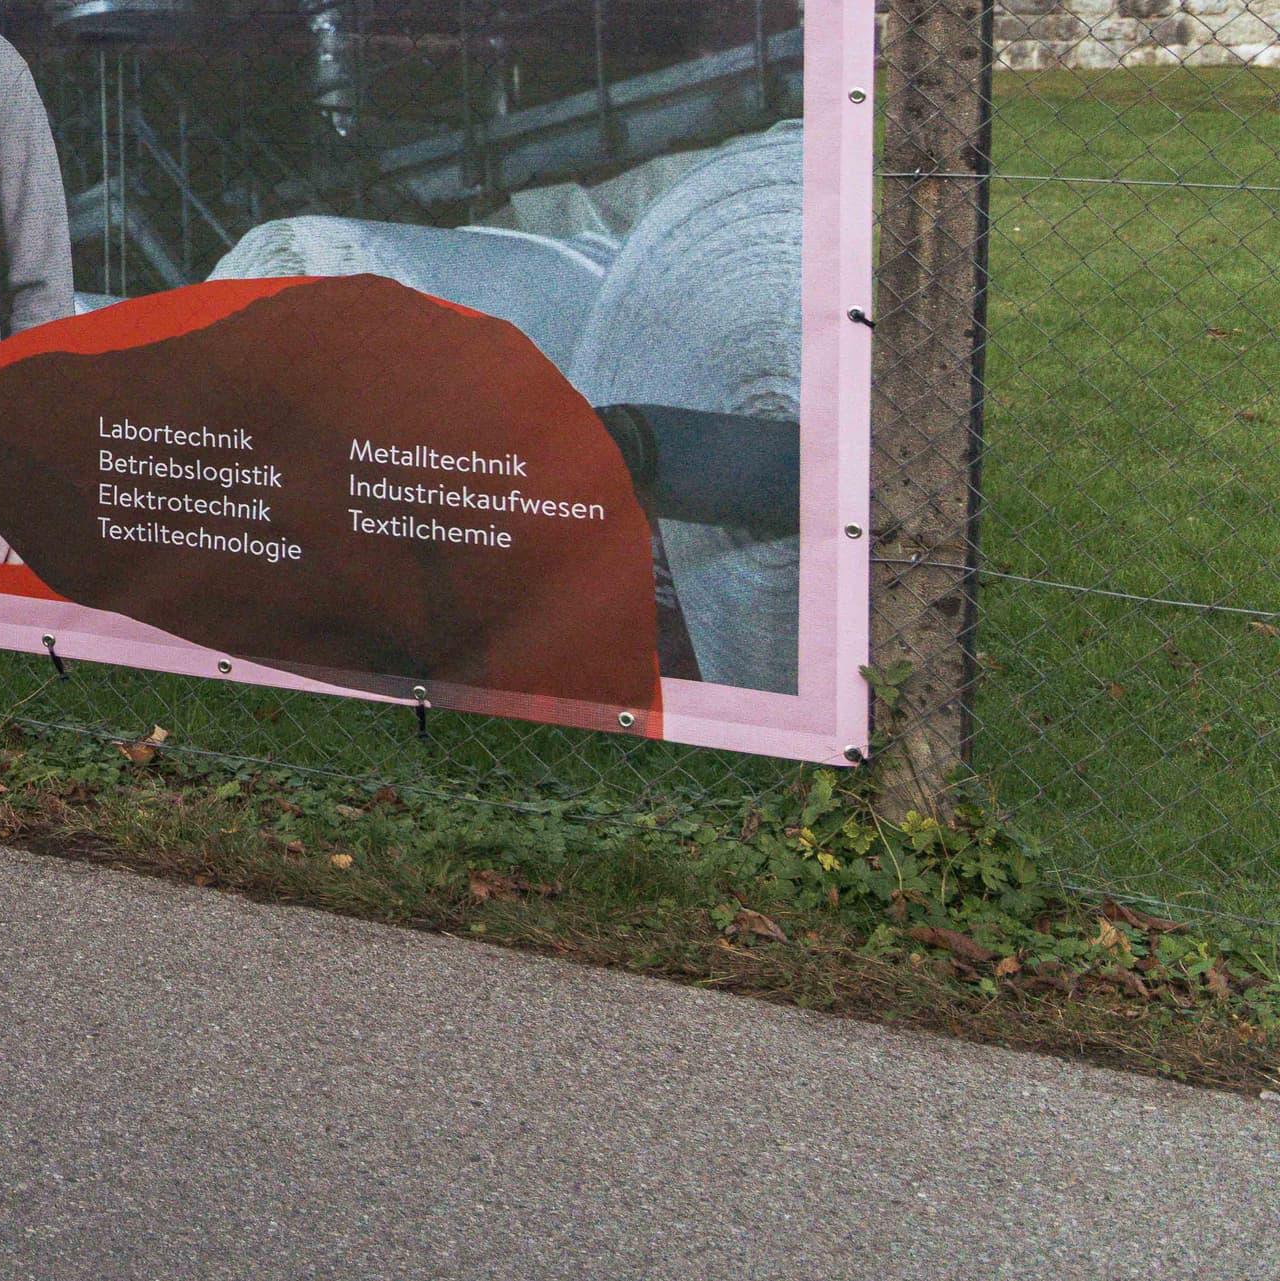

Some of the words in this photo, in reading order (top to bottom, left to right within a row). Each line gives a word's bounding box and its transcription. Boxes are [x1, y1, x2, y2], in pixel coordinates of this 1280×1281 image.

[98, 417, 254, 451] Labortechnik
[98, 450, 283, 489] Betriebslogistik
[349, 439, 528, 478] Metalltechnik
[98, 484, 272, 523] Elektrotechnik
[348, 474, 605, 521] Industriekaufwesen
[97, 517, 303, 563] Textiltechnologie
[348, 509, 513, 549] Textilchemie
